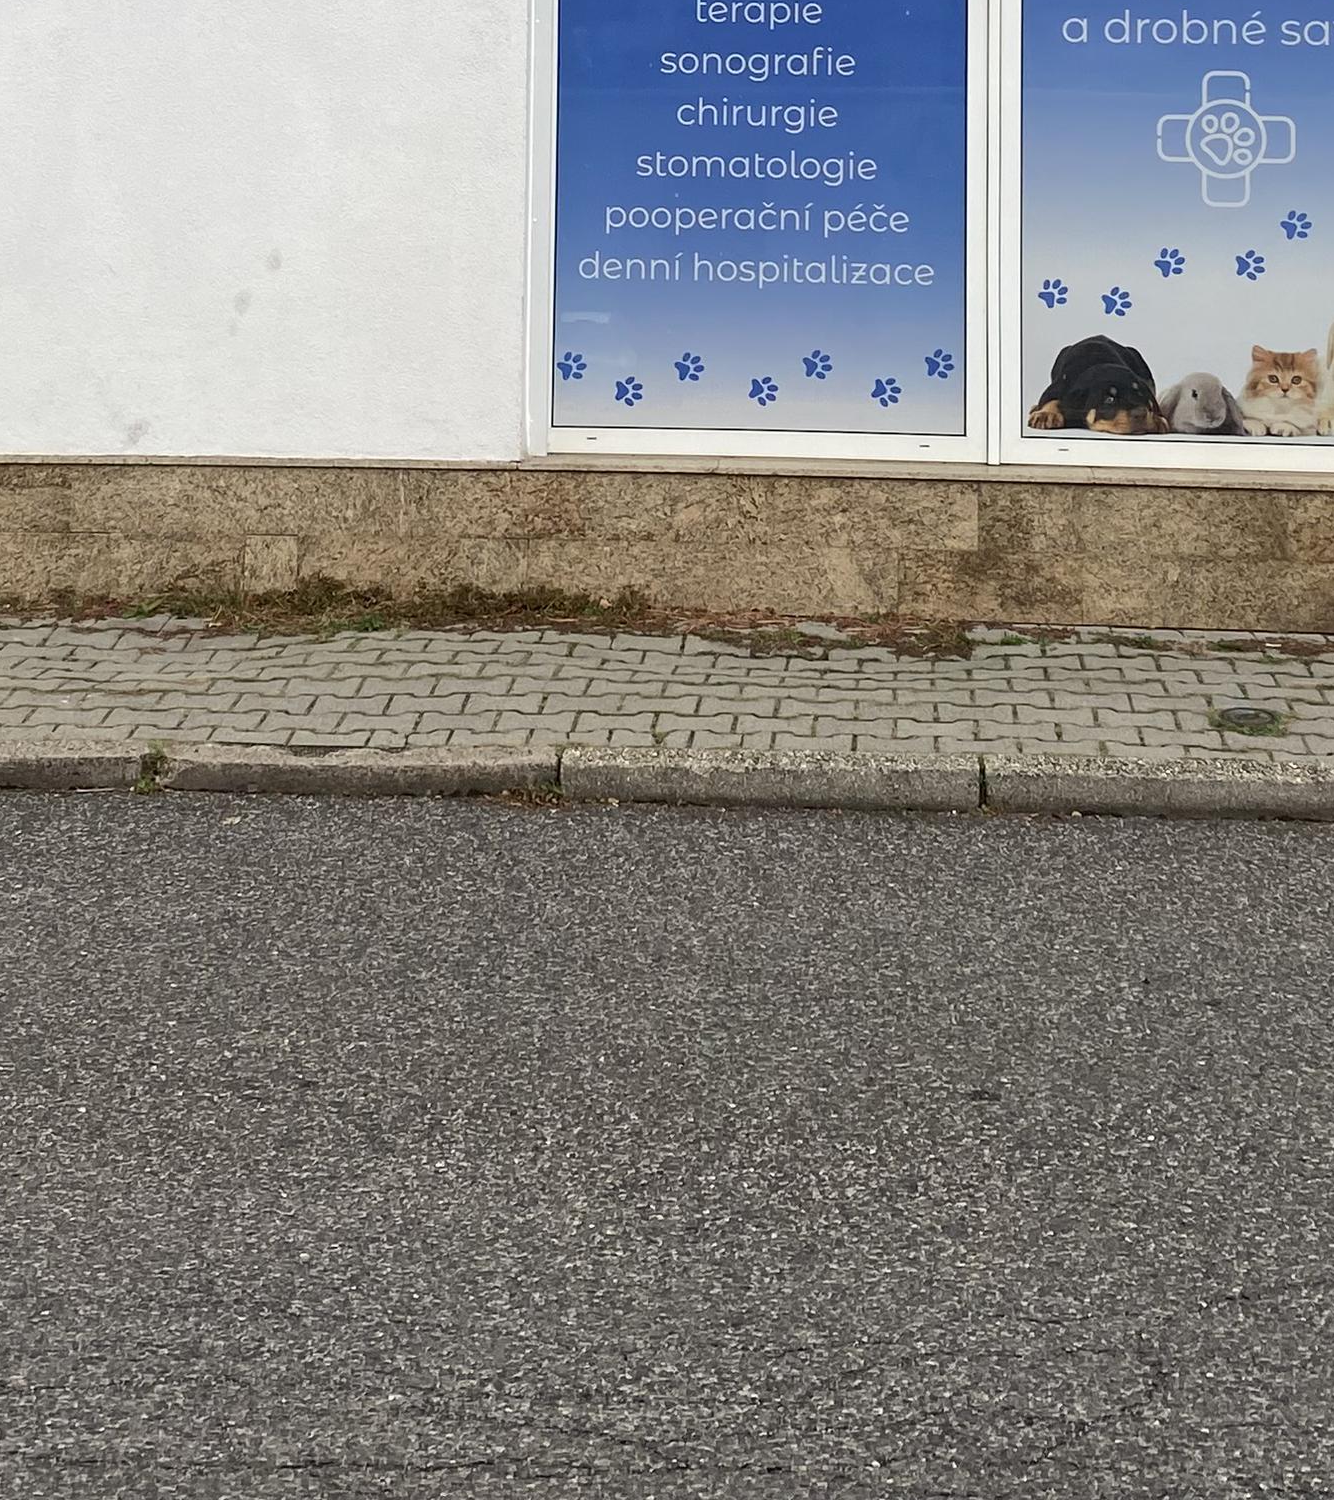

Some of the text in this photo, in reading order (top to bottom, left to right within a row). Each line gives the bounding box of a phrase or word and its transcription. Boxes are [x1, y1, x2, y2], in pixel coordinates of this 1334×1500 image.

[1061, 16, 1088, 44] a
[1103, 9, 1267, 45] drobné
[659, 46, 856, 82] sonografie
[676, 96, 839, 134] chirurgie
[635, 150, 878, 187] stomatologie
[604, 201, 910, 238] pooperační péče
[578, 250, 935, 289] denní hospitalizace
